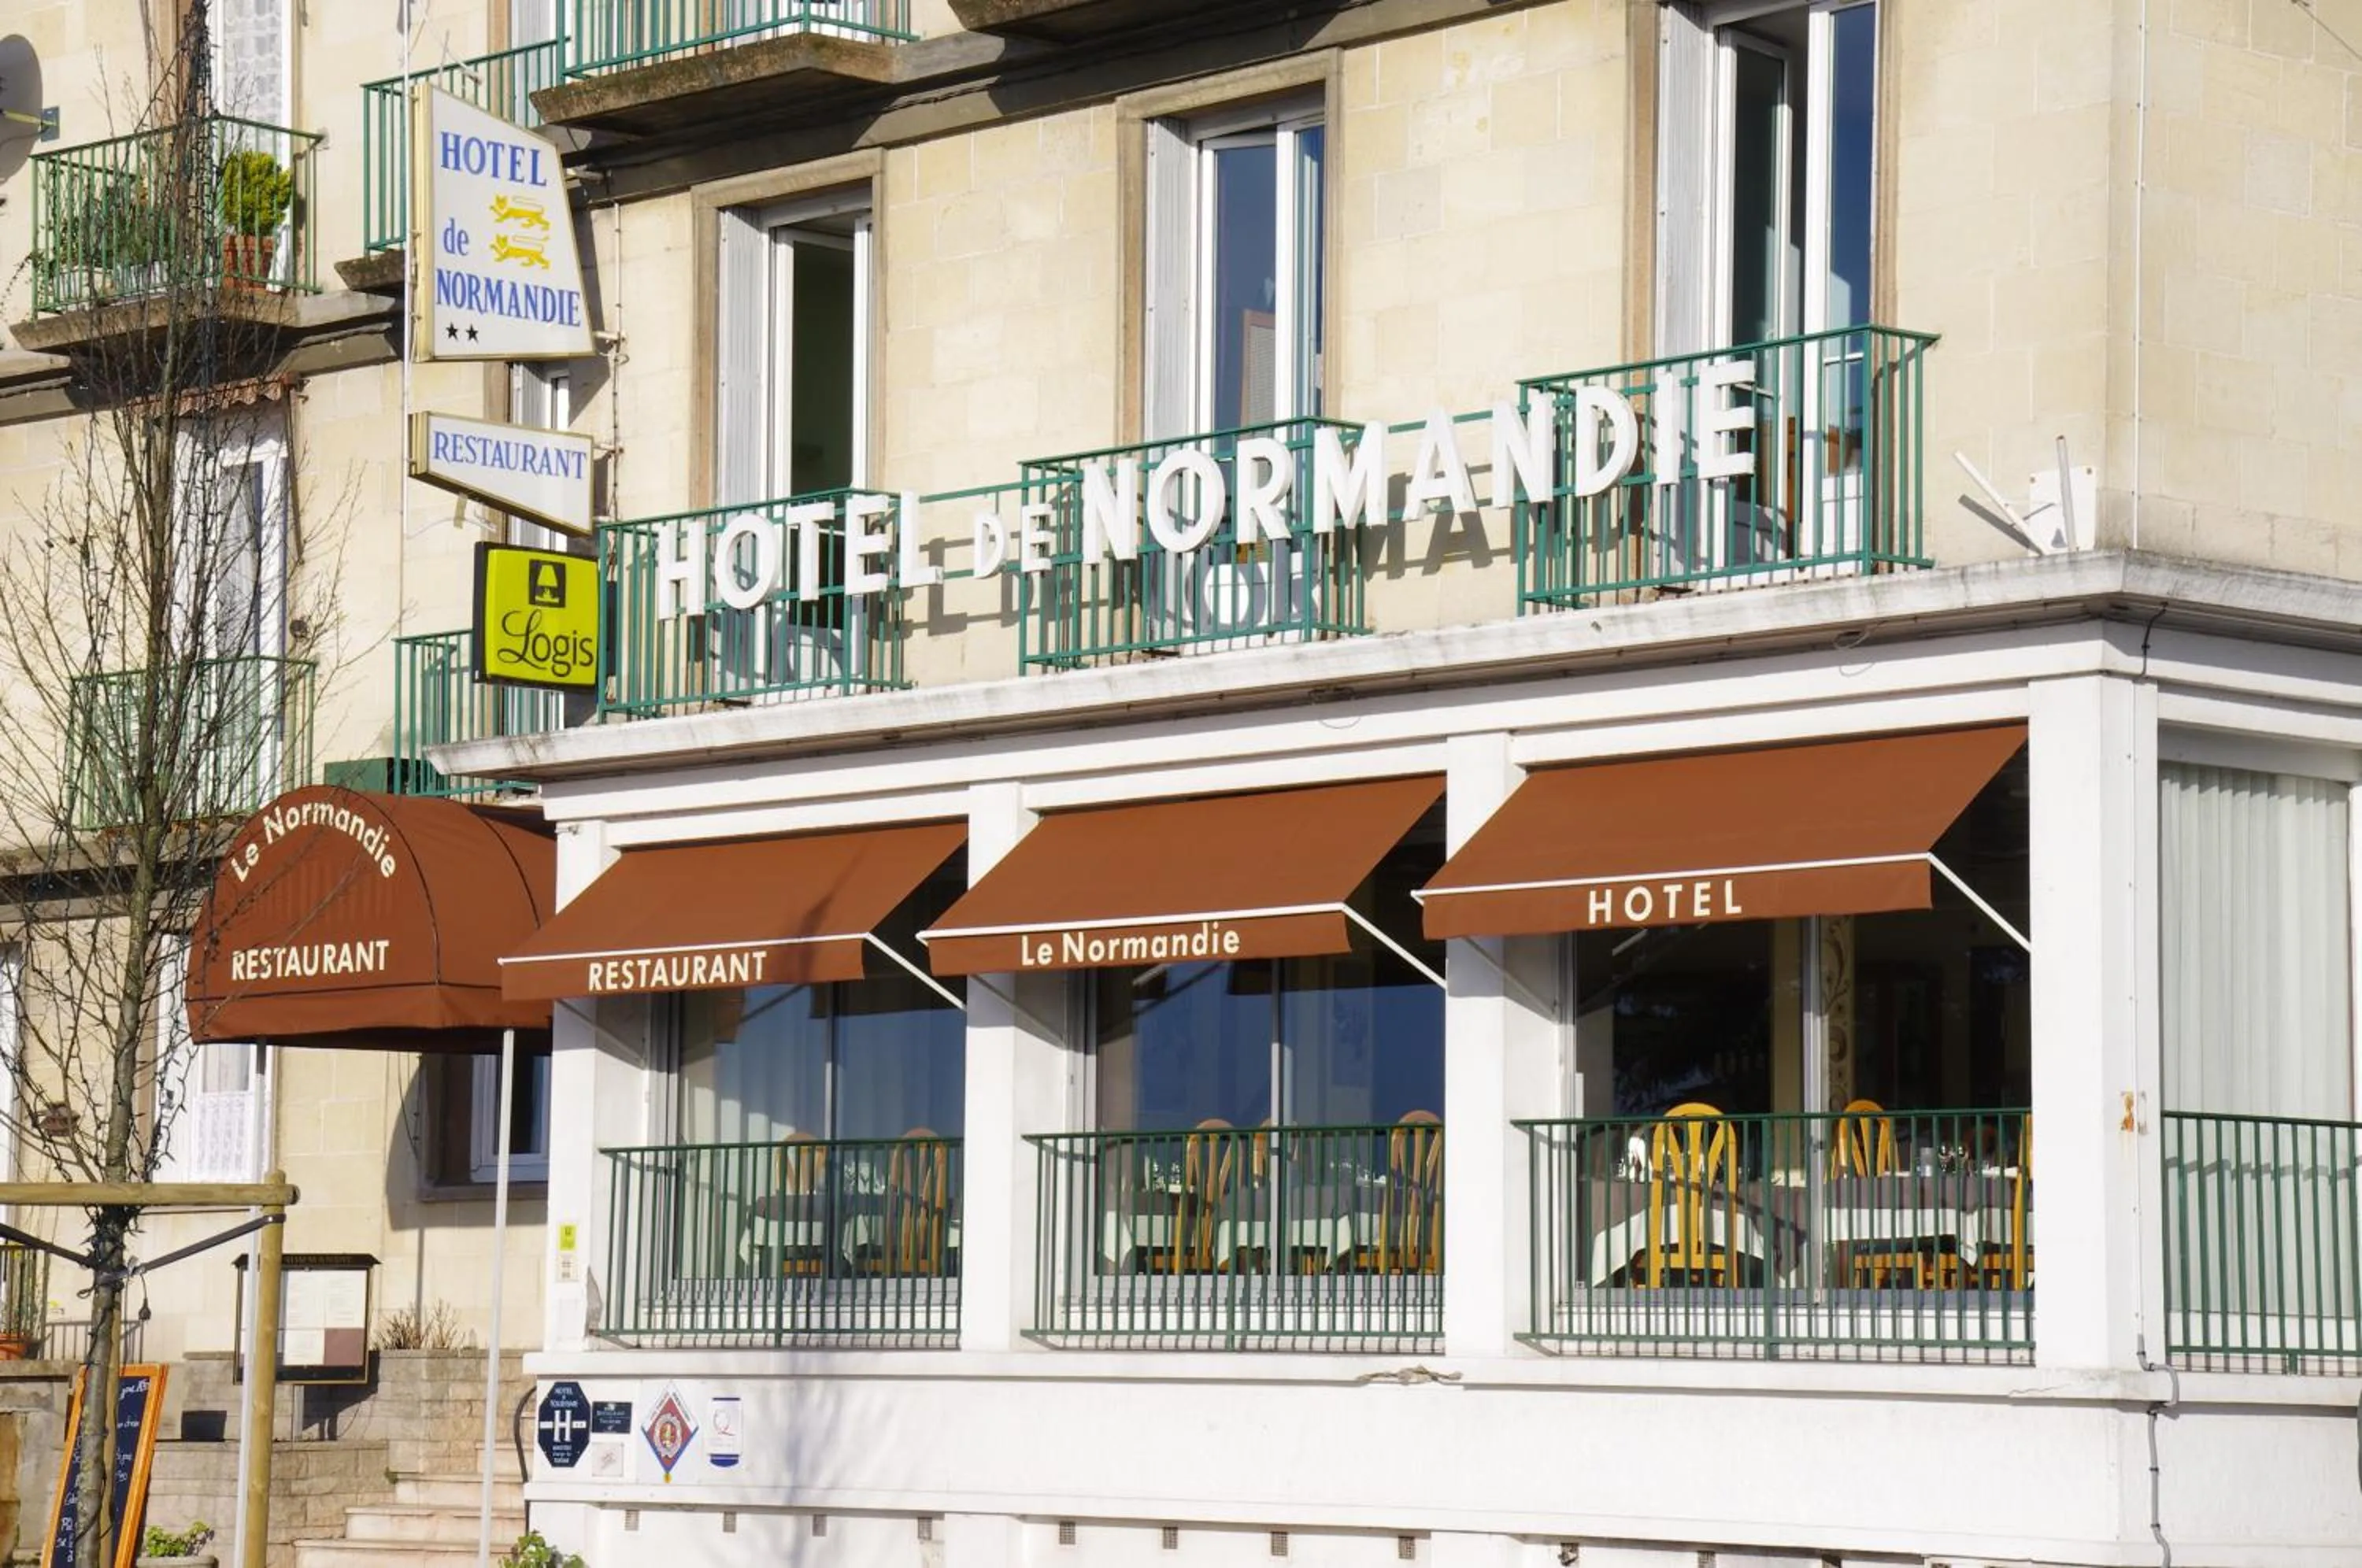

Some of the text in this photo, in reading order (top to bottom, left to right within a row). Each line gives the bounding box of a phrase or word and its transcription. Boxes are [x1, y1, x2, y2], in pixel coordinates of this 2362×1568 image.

[440, 131, 546, 187] HOTEL
[443, 218, 469, 256] de
[436, 268, 581, 327] NORMANDIE
[433, 431, 587, 479] RESTAURANT
[656, 360, 1756, 620] HOTEL DE NORMANDIE
[497, 608, 594, 678] Logis
[231, 801, 396, 882] Le Normandie
[1588, 879, 1742, 925] HOTEL
[231, 941, 390, 982] RESTAURANT
[1021, 921, 1241, 967] Le Normandie
[588, 951, 768, 992] RESTAURANT
[553, 1409, 572, 1443] H
